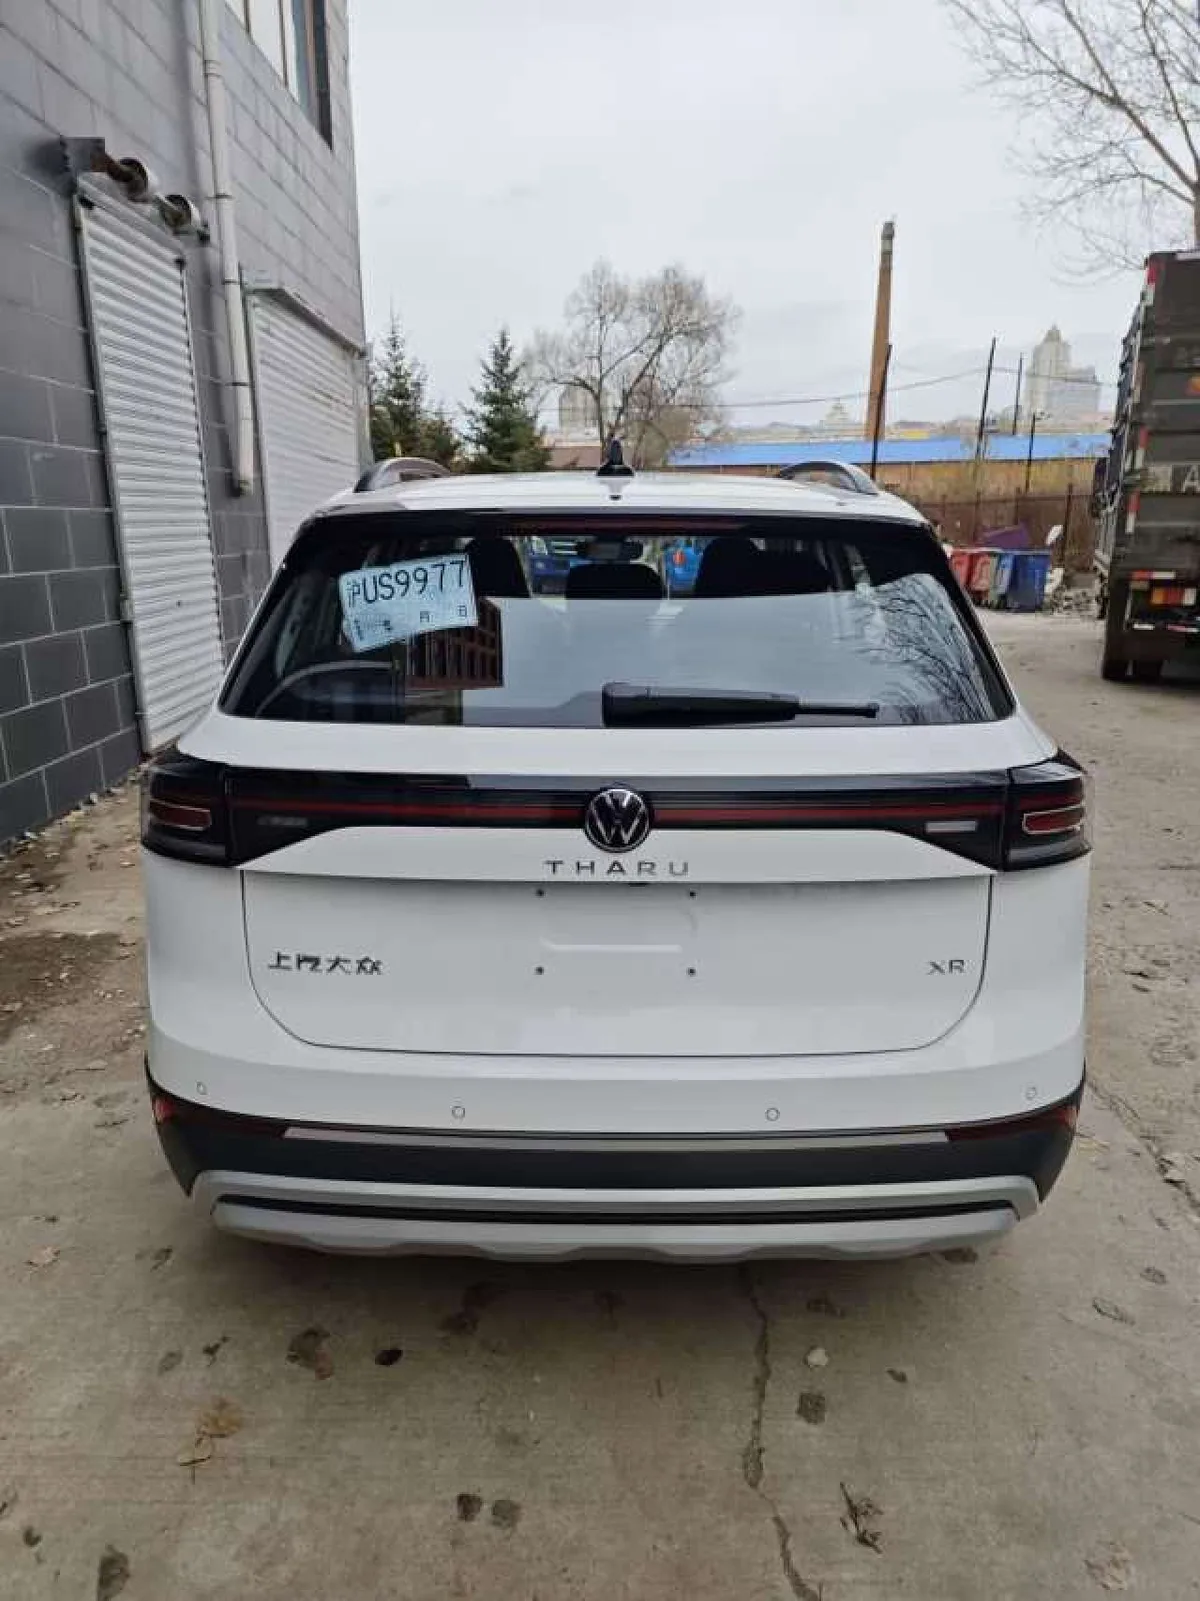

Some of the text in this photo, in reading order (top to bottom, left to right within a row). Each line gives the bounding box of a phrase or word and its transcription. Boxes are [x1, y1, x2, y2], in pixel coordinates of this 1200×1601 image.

[346, 560, 464, 607] 沪US9977
[545, 860, 689, 876] THARU
[267, 952, 382, 975] 上汽大众
[926, 960, 965, 975] XR
